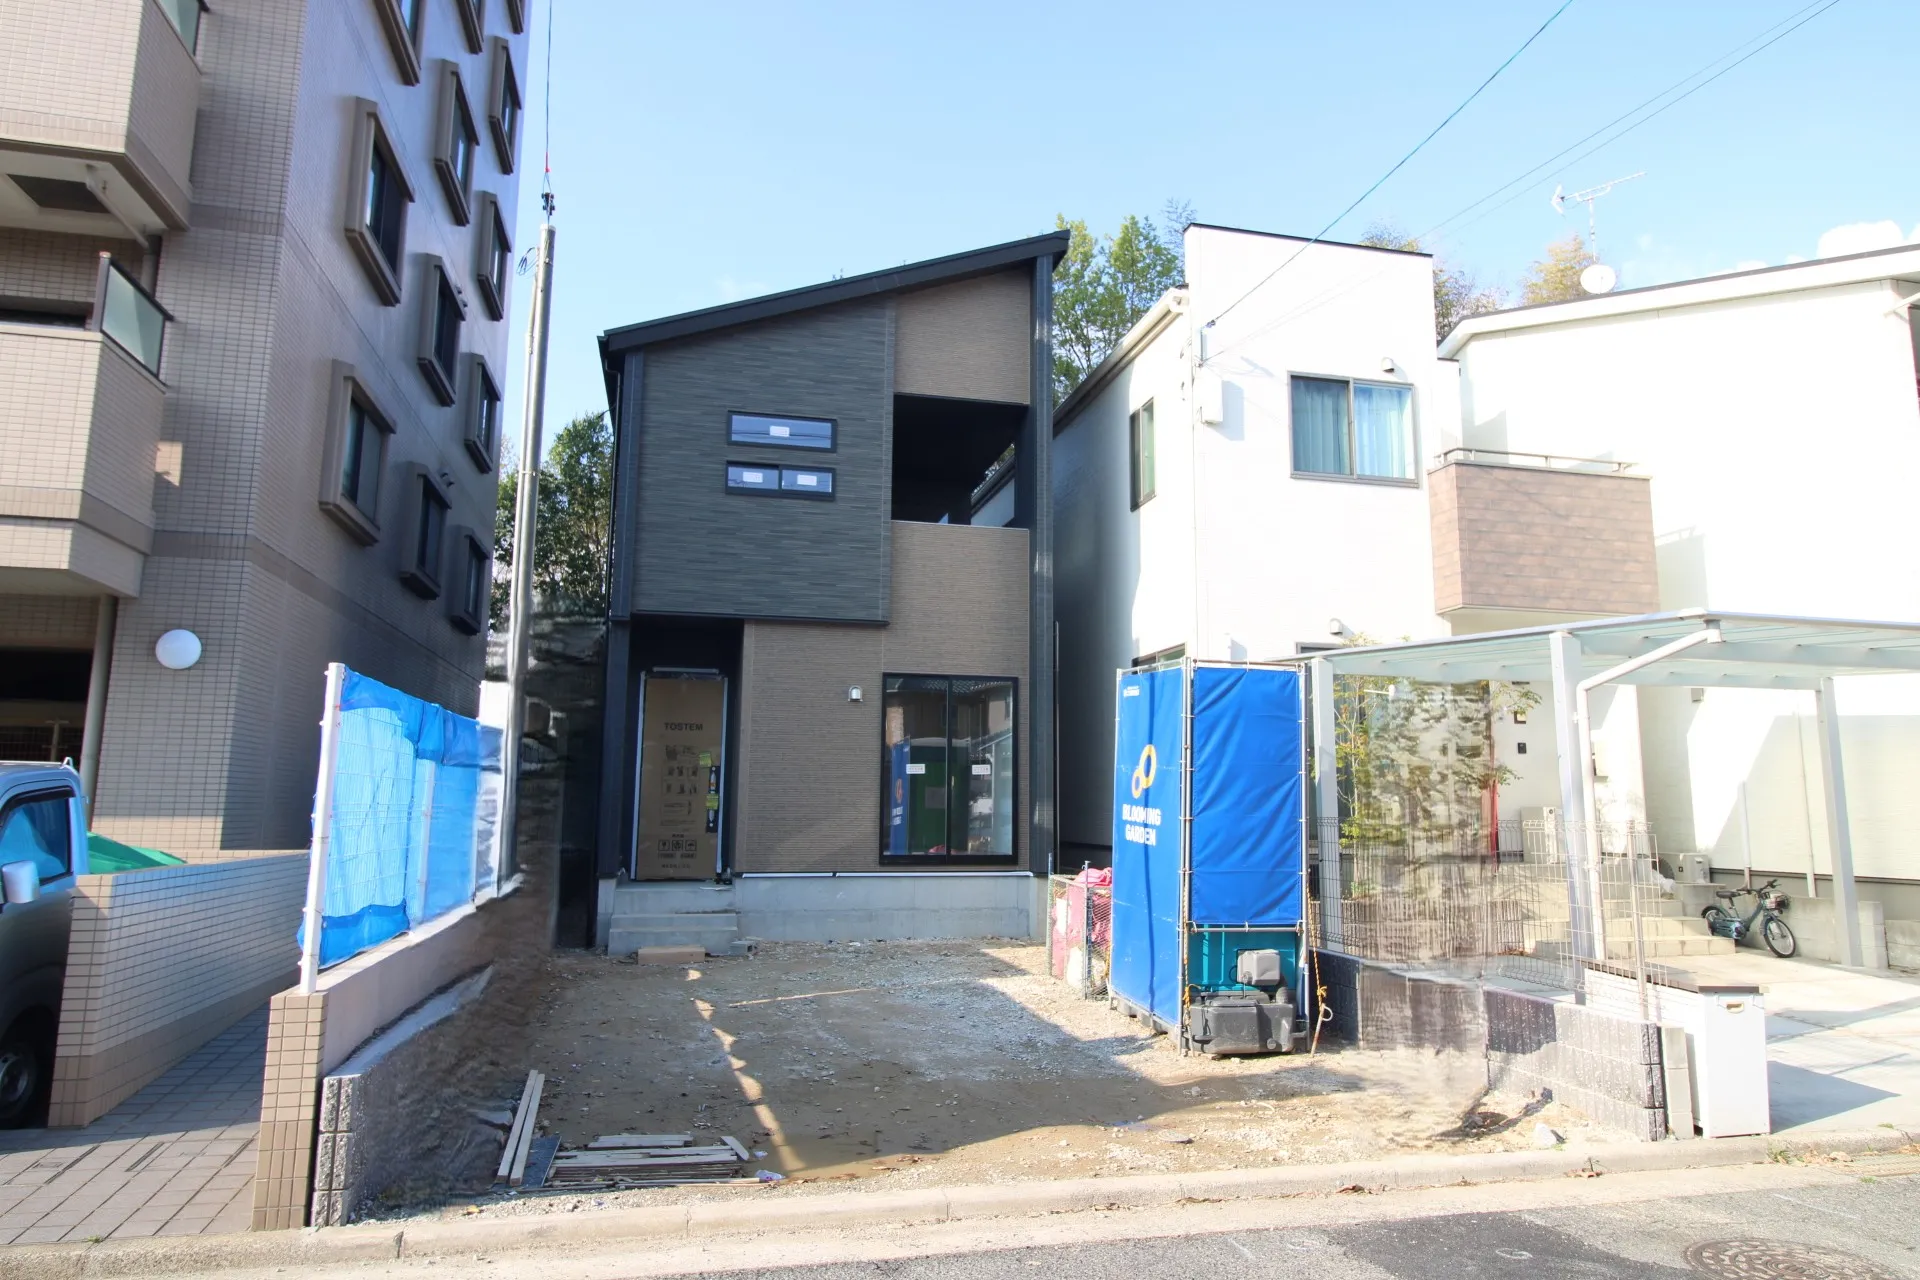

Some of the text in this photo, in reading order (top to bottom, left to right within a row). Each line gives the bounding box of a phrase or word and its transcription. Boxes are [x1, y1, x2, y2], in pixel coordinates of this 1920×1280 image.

[664, 723, 703, 732] TOSTEM
[1122, 803, 1161, 826] BLOOMING
[1125, 824, 1156, 847] GARDEN
